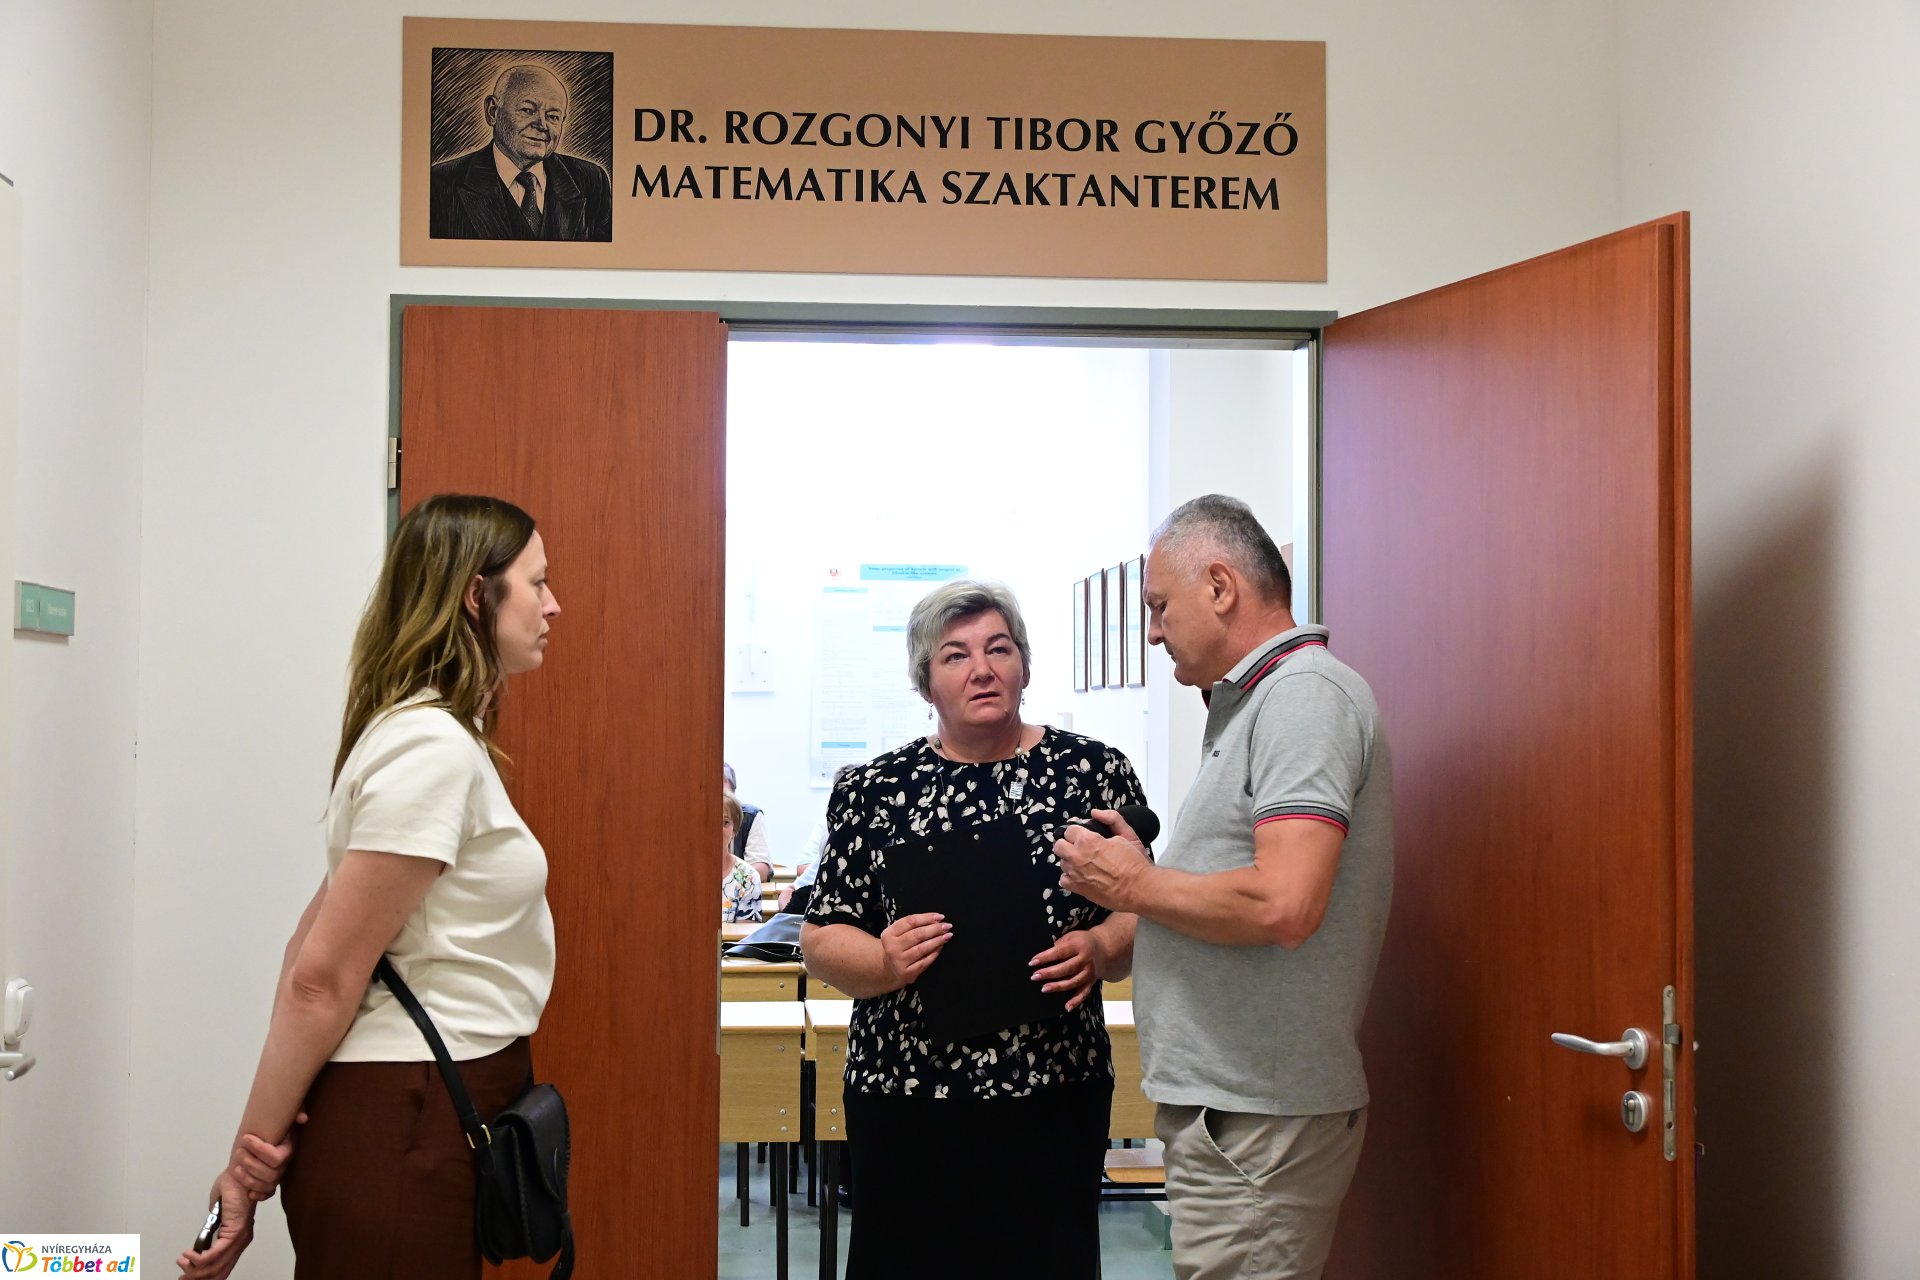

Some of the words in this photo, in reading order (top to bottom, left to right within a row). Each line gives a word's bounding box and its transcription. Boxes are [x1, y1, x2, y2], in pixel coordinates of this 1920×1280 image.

[634, 108, 707, 144] DR.
[725, 110, 970, 149] ROZGONYI
[986, 116, 1121, 153] TIBOR
[1134, 110, 1299, 157] GYŐZŐ
[631, 164, 927, 204] MATEMATIKA
[942, 170, 1280, 211] SZAKTANTEREM
